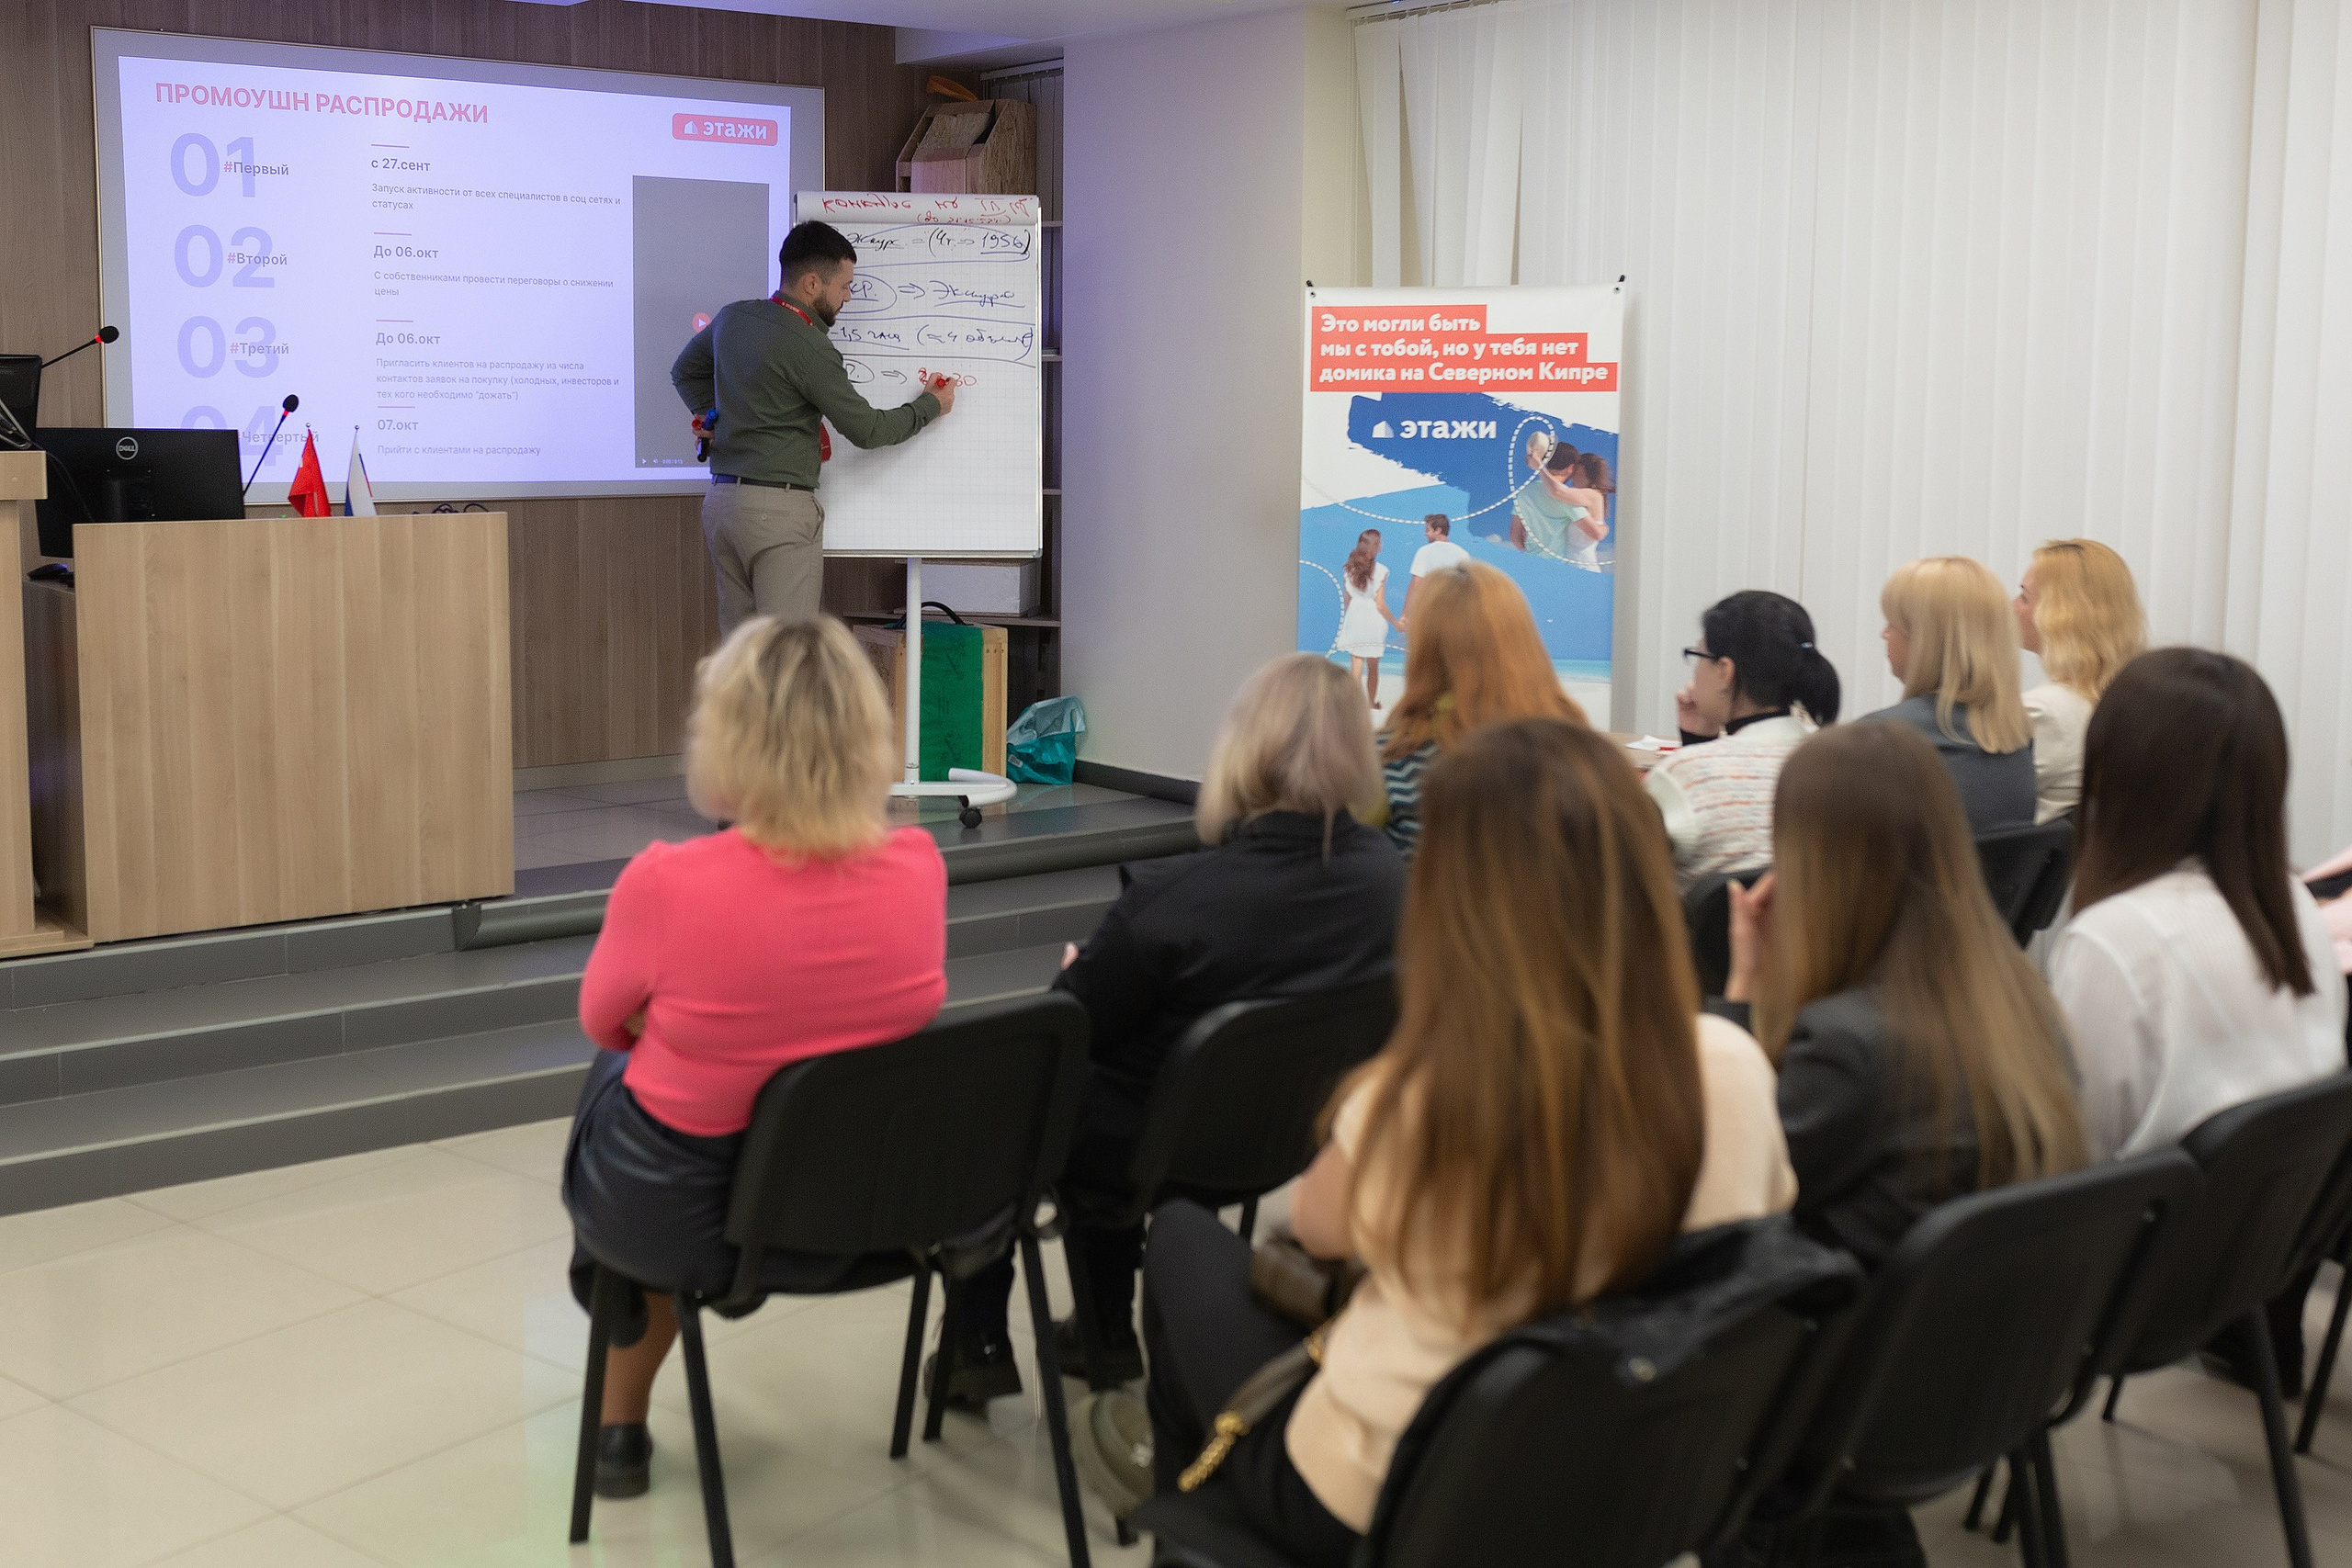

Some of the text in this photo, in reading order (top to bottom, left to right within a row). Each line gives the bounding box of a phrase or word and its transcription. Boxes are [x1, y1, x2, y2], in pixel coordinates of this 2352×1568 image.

[155, 82, 489, 124] ПРОМОУШН РАСПРОДАЖИ
[702, 120, 768, 140] этажи
[170, 132, 257, 198] 01
[223, 160, 290, 176] #Первый
[370, 158, 432, 173] с 27.сент
[371, 183, 405, 195] Запуск
[406, 186, 461, 197] активности
[462, 189, 474, 198] от
[475, 189, 497, 199] всех
[498, 191, 561, 203] специалистов
[562, 195, 570, 204] в
[570, 196, 588, 206] соц
[589, 196, 615, 206] сетях
[371, 198, 414, 211] статусах
[174, 224, 276, 288] 02
[226, 252, 288, 267] #Второй
[373, 244, 440, 260] До 06.окт
[374, 270, 616, 289] С собственниками провести переговоры о снижении
[374, 287, 401, 299] цены
[1320, 312, 1481, 333] Это могли быть
[177, 315, 280, 379] 03
[375, 332, 442, 347] До 06.окт
[229, 341, 290, 357] #Третий
[1320, 336, 1579, 361] мы с тобой, но у тебя нет
[376, 357, 585, 373] Пригласить клиентов на распродажу из числа
[376, 375, 424, 385] контактов
[424, 376, 458, 385] заявок
[458, 377, 471, 385] на
[471, 377, 509, 388] покупку
[561, 377, 613, 388] инвесторов
[613, 378, 620, 387] и
[1318, 362, 1608, 385] домика на Северном Кипре
[377, 390, 393, 400] тех
[394, 390, 416, 400] кого
[417, 389, 474, 400] необходимо
[377, 419, 419, 432] 07.окт
[1399, 420, 1497, 440] этажи
[377, 444, 413, 455] Прийти
[421, 446, 471, 455] клиентами
[472, 446, 484, 455] на
[485, 446, 541, 457] распродажу
